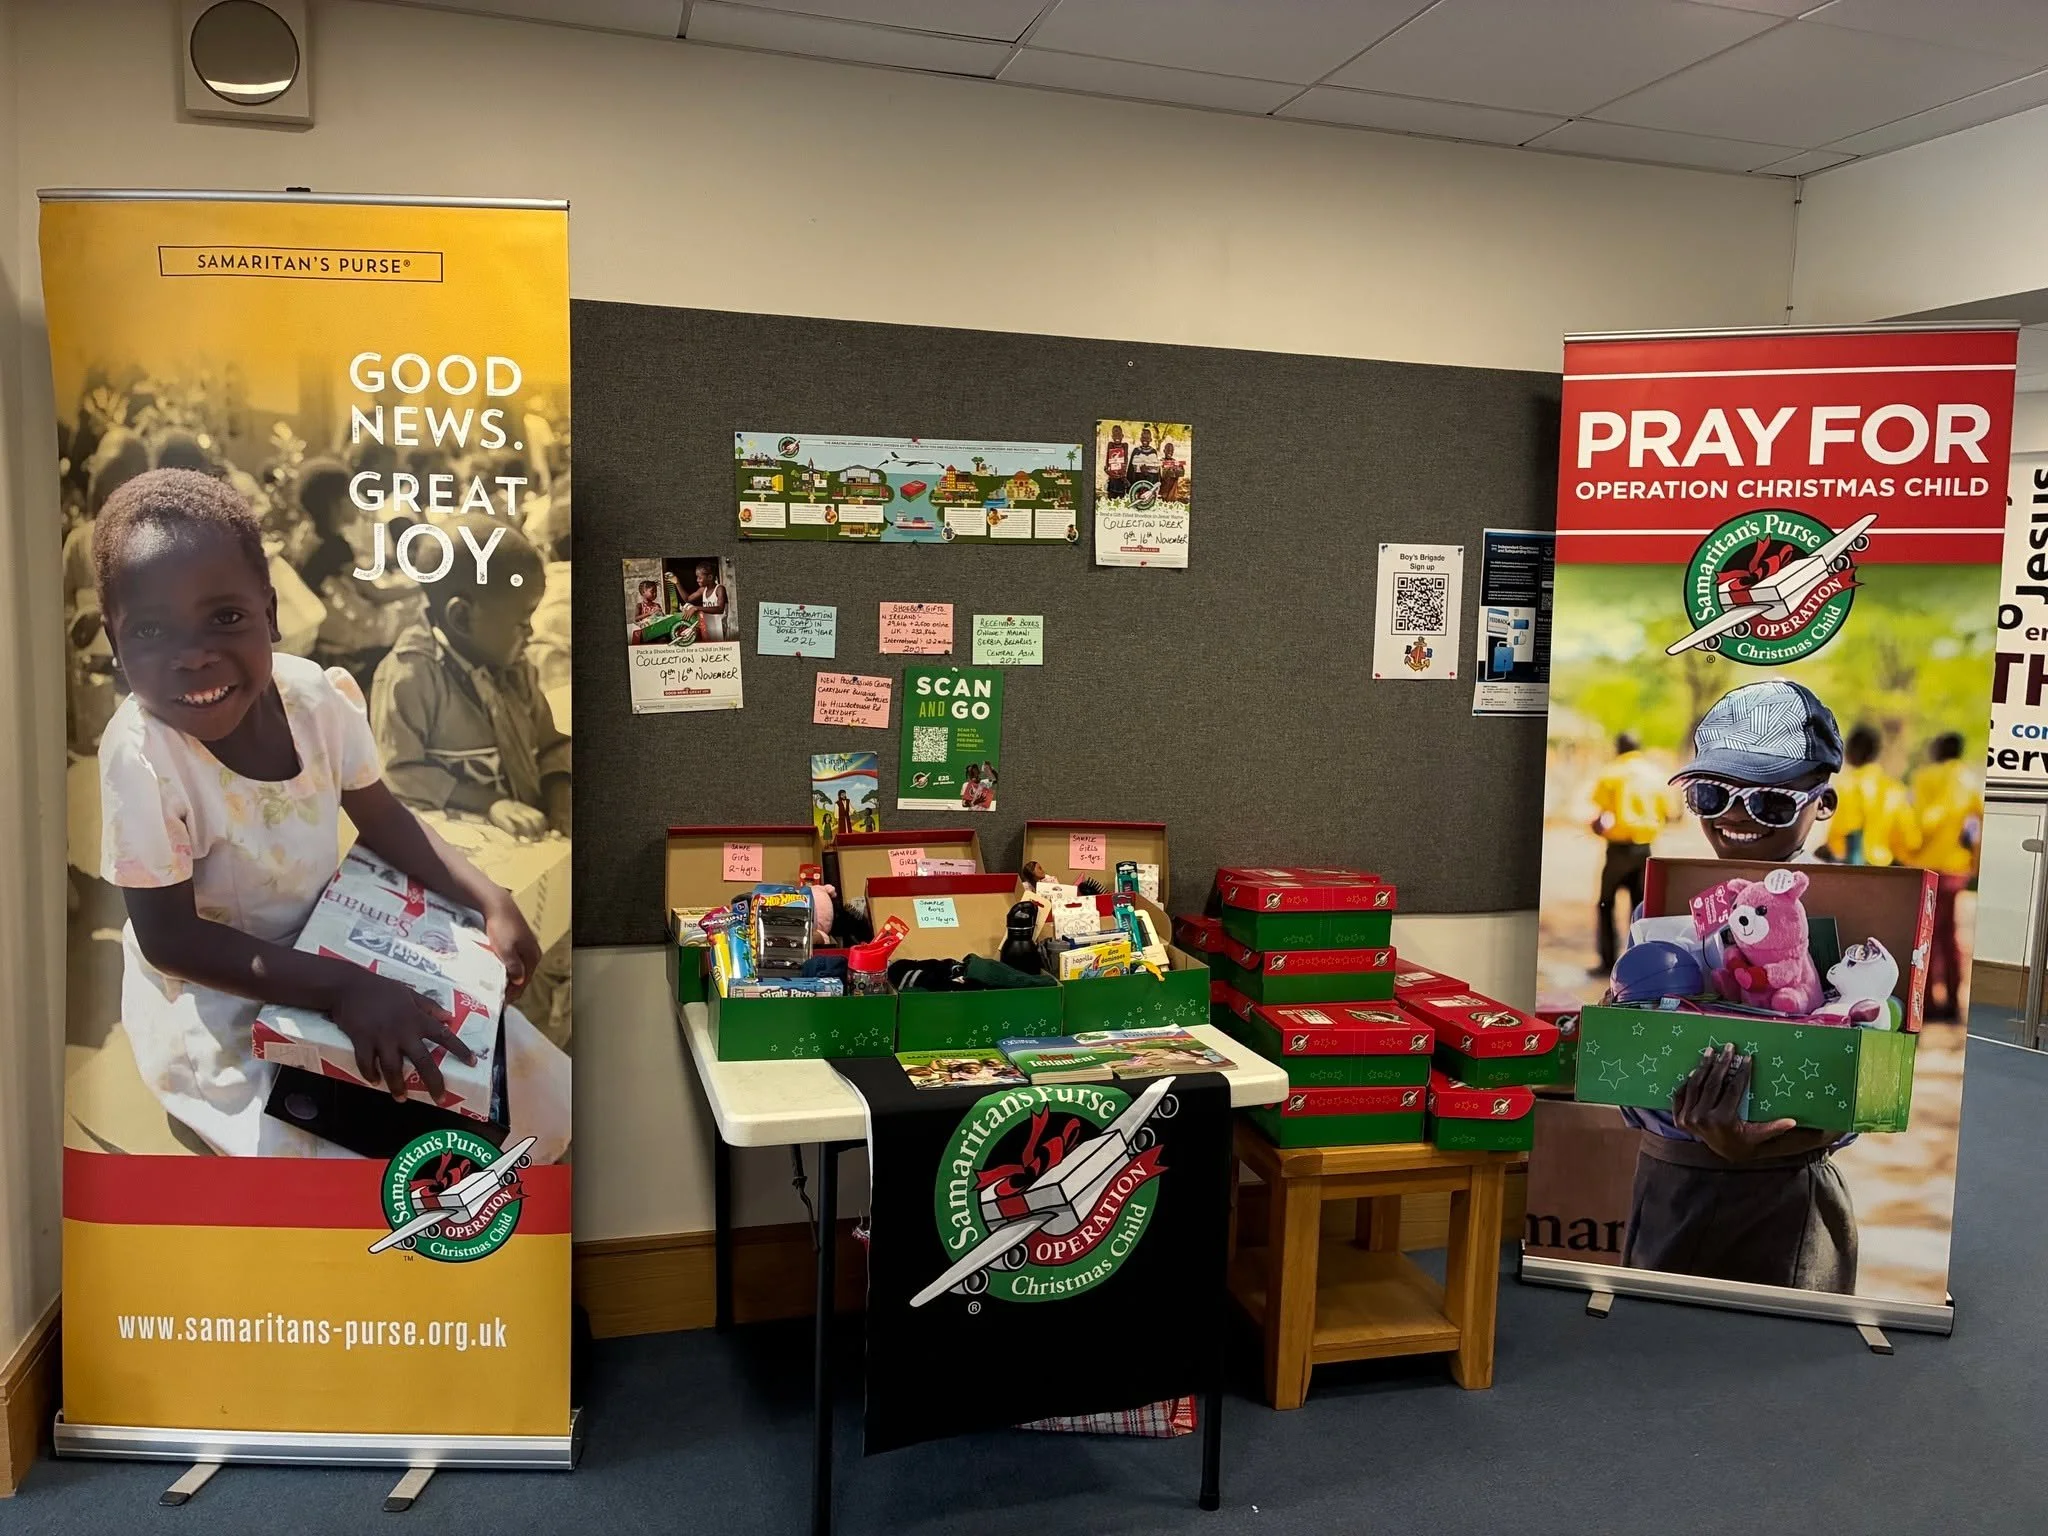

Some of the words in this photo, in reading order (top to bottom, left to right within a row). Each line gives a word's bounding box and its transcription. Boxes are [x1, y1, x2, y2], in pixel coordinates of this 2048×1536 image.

[197, 254, 331, 273] SAMARITAN'S
[349, 351, 522, 397] GOOD
[351, 405, 524, 450] NEWS.
[1577, 406, 1798, 469] PRAY
[1808, 403, 1991, 467] FOR
[349, 472, 528, 517] GREAT
[1575, 480, 1728, 500] OPERATION
[1737, 478, 1895, 499] CHRISTMAS
[1904, 477, 1989, 497] CHILD
[352, 522, 524, 587] JOY.
[1400, 553, 1418, 561] Boy's
[1420, 554, 1445, 562] Brigade
[1409, 563, 1424, 571] Sign
[1695, 519, 1761, 622] Samaritan's
[1763, 514, 1821, 550] Purse
[1756, 577, 1843, 639] OPERATION
[1736, 635, 1813, 660] Christmas
[1811, 604, 1842, 640] Child
[636, 655, 694, 667] COLLECTION
[700, 654, 730, 663] WEEK
[916, 676, 992, 698] SCAN
[919, 701, 945, 718] AND
[951, 700, 990, 720] GO
[1028, 1055, 1096, 1067] Testament
[392, 1133, 443, 1222] Samaritan's
[445, 1131, 492, 1166] Purse
[948, 1086, 1034, 1251] Samaritan's
[1034, 1084, 1117, 1120] Purse
[445, 1188, 512, 1239] OPERATION
[1035, 1162, 1147, 1261] OPERATION
[430, 1240, 492, 1259] Christmas
[488, 1212, 513, 1243] Child
[1011, 1260, 1113, 1296] Christmas
[1110, 1202, 1147, 1258] Child
[118, 1312, 508, 1351] www.samaritans-purse.org.uk
